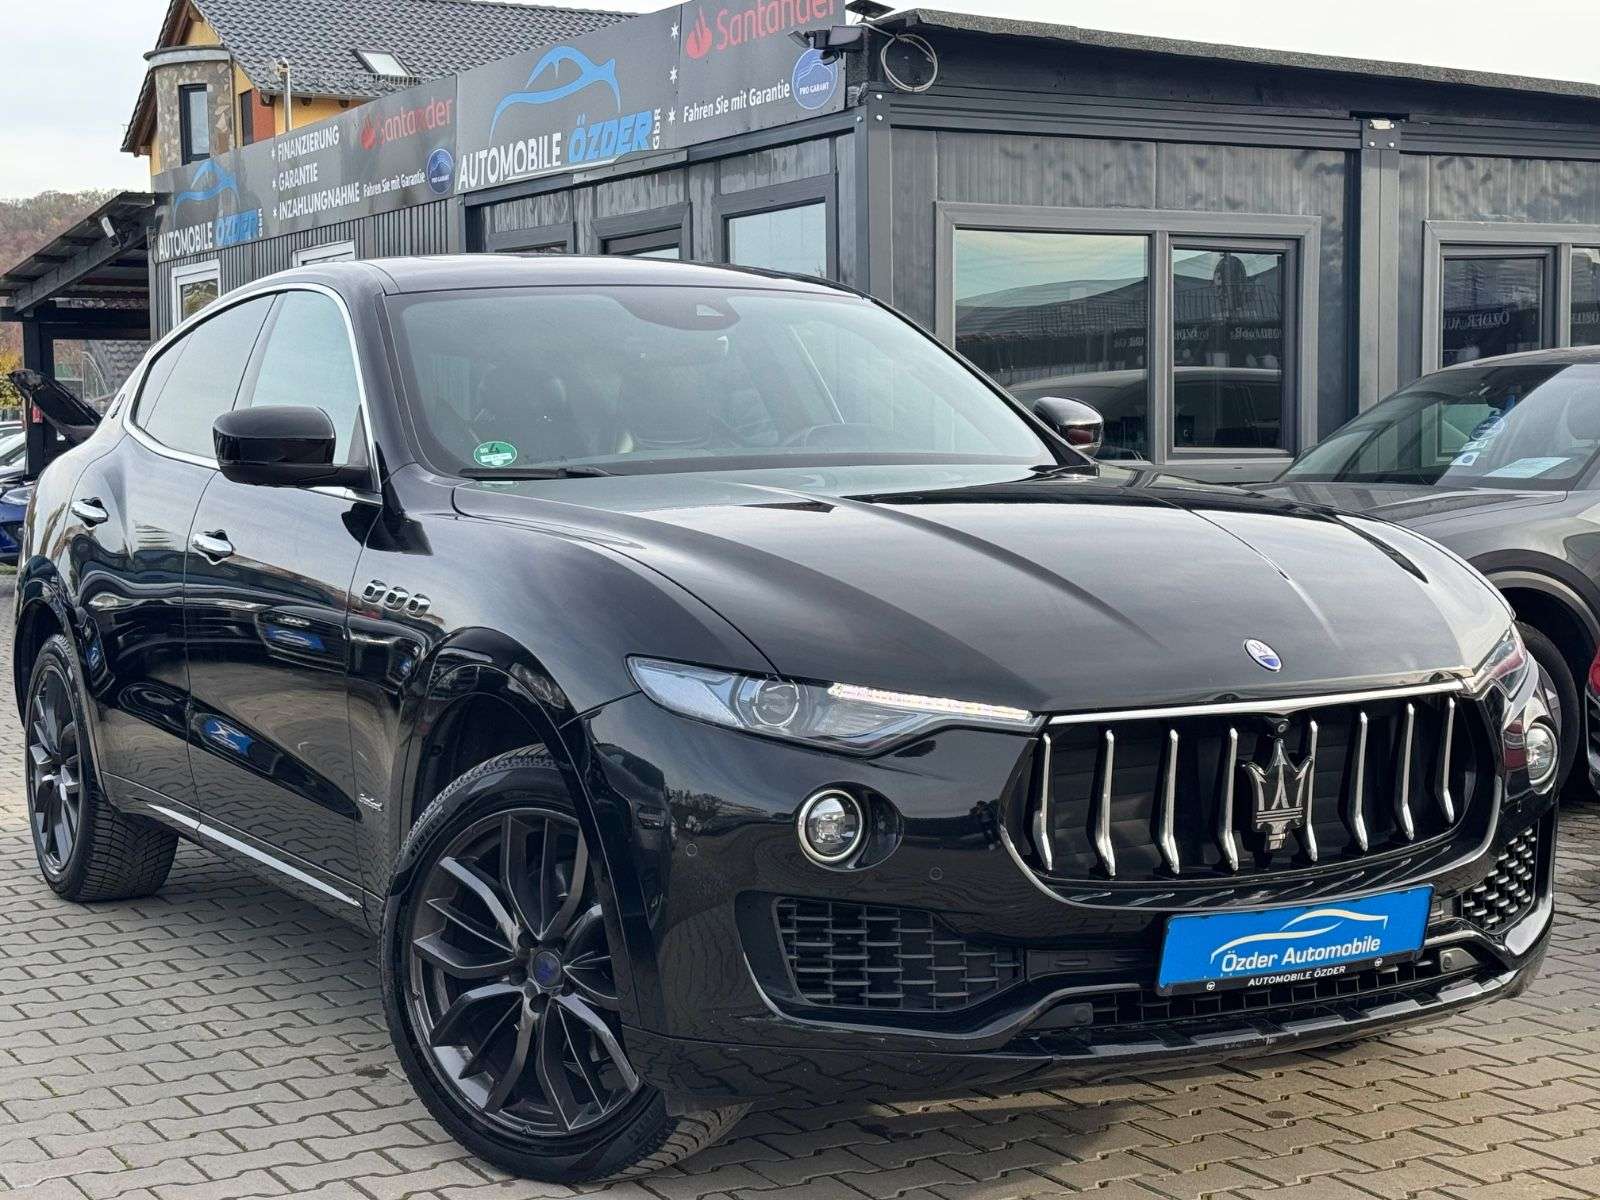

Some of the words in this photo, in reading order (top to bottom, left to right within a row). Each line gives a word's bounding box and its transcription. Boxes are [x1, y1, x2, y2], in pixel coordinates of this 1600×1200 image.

[683, 102, 714, 123] Fahren
[715, 95, 729, 115] Sie
[730, 90, 747, 111] mit
[750, 79, 790, 107] Garantie
[277, 124, 340, 162] FINANZIERUNG
[458, 132, 562, 190] AUTOMOBILE
[568, 110, 653, 163] ÖZDER
[278, 162, 318, 191] GARANTIE
[401, 168, 426, 188] Garantie
[279, 181, 361, 220] INZAHLUNGNAHME
[159, 221, 213, 260] AUTOMOBILE
[1221, 950, 1279, 973] Özder
[1281, 935, 1381, 966] Automobile
[1248, 971, 1312, 987] AUTOMOBILE
[1314, 965, 1346, 978] ÖZDER
